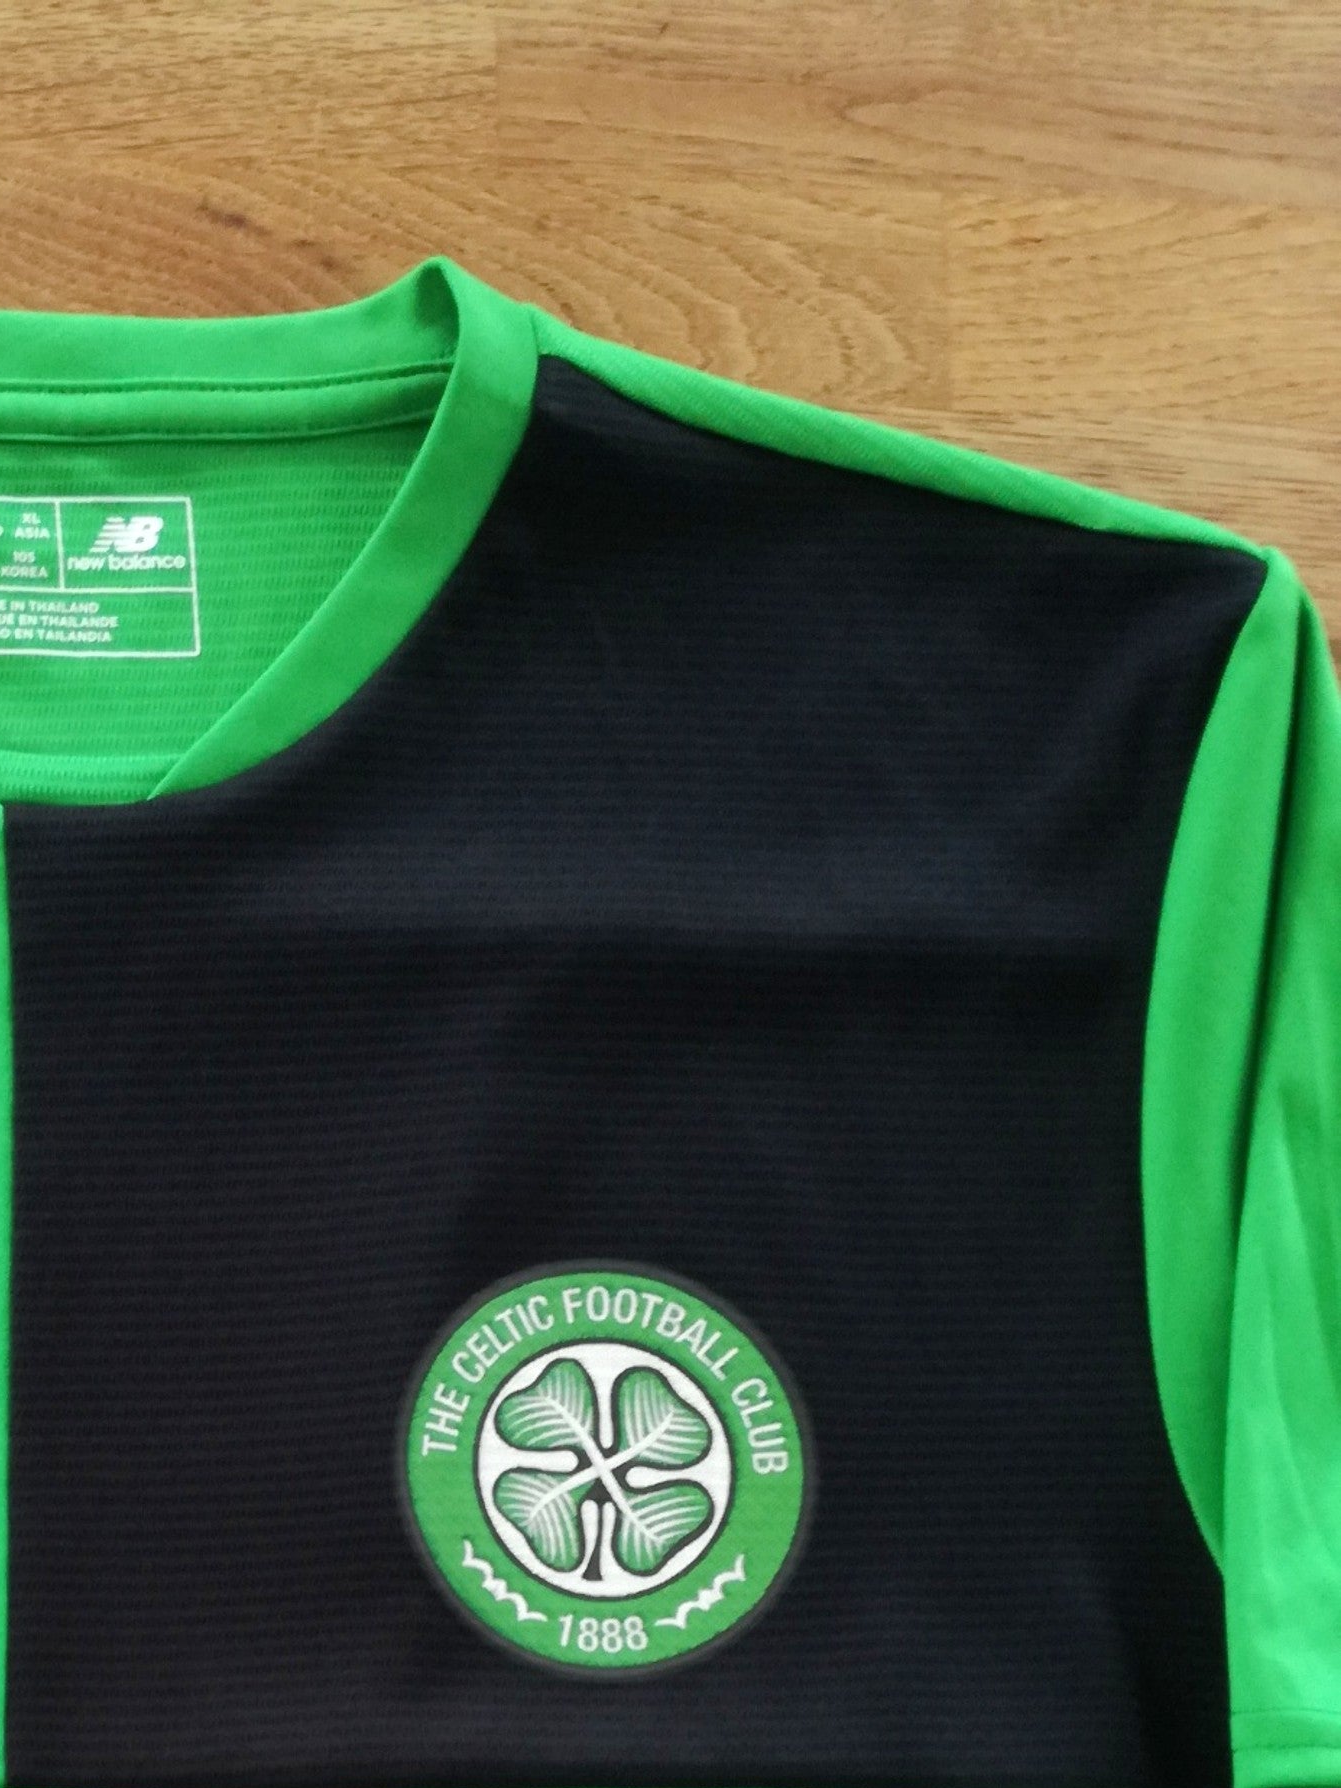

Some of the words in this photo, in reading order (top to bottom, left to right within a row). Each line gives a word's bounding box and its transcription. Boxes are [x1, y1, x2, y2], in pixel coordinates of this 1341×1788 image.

[22, 511, 41, 525] XL
[14, 526, 50, 540] ASIA
[67, 556, 107, 572] new
[108, 553, 187, 571] balance
[0, 565, 49, 579] KOREA
[10, 600, 26, 612] IN
[28, 600, 100, 614] THAILAND
[18, 613, 38, 626] EN
[14, 627, 35, 640] EN
[36, 628, 113, 643] TAILANDIA
[422, 1382, 470, 1458] THE
[451, 1294, 555, 1385] CELTIC
[563, 1286, 740, 1383] FOOTBALL
[729, 1376, 790, 1476] CLUB
[558, 1613, 649, 1653] 1888
